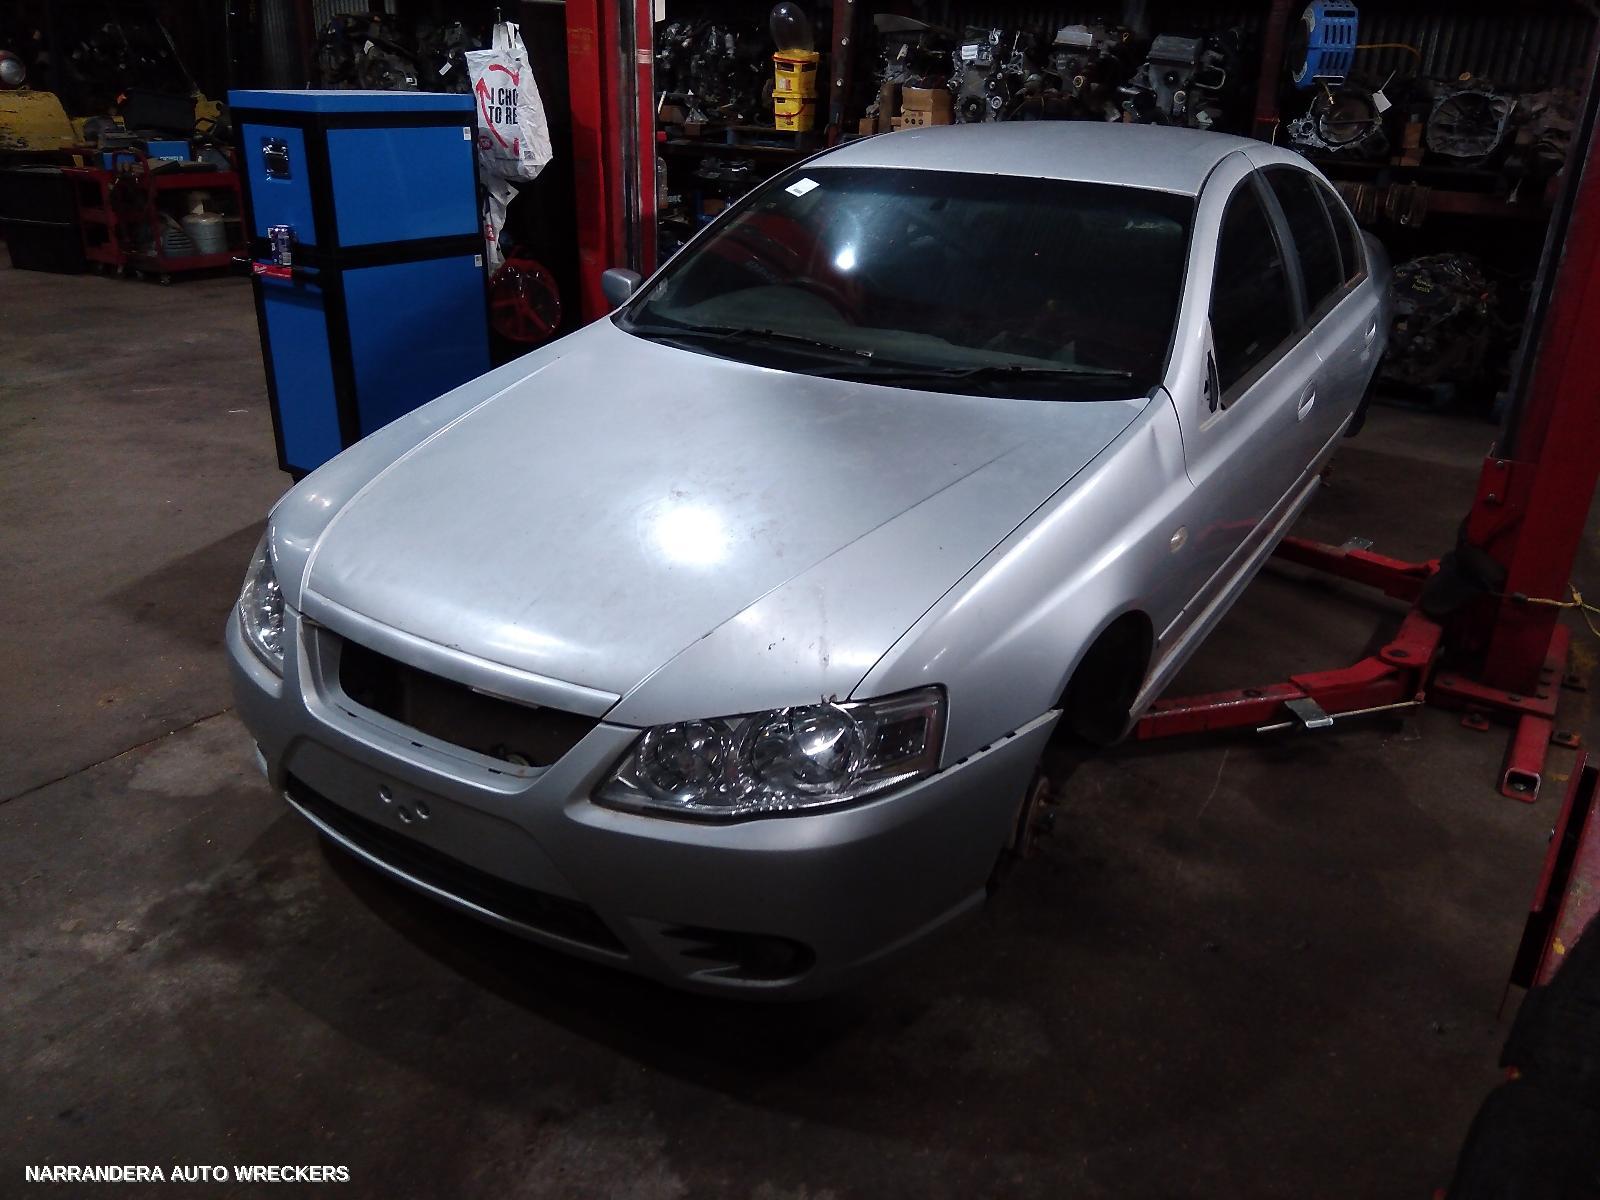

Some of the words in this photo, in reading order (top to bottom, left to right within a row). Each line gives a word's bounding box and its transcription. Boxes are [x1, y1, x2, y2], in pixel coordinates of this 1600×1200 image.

[490, 87, 495, 105] I
[488, 105, 502, 124] TO
[505, 106, 519, 125] RE
